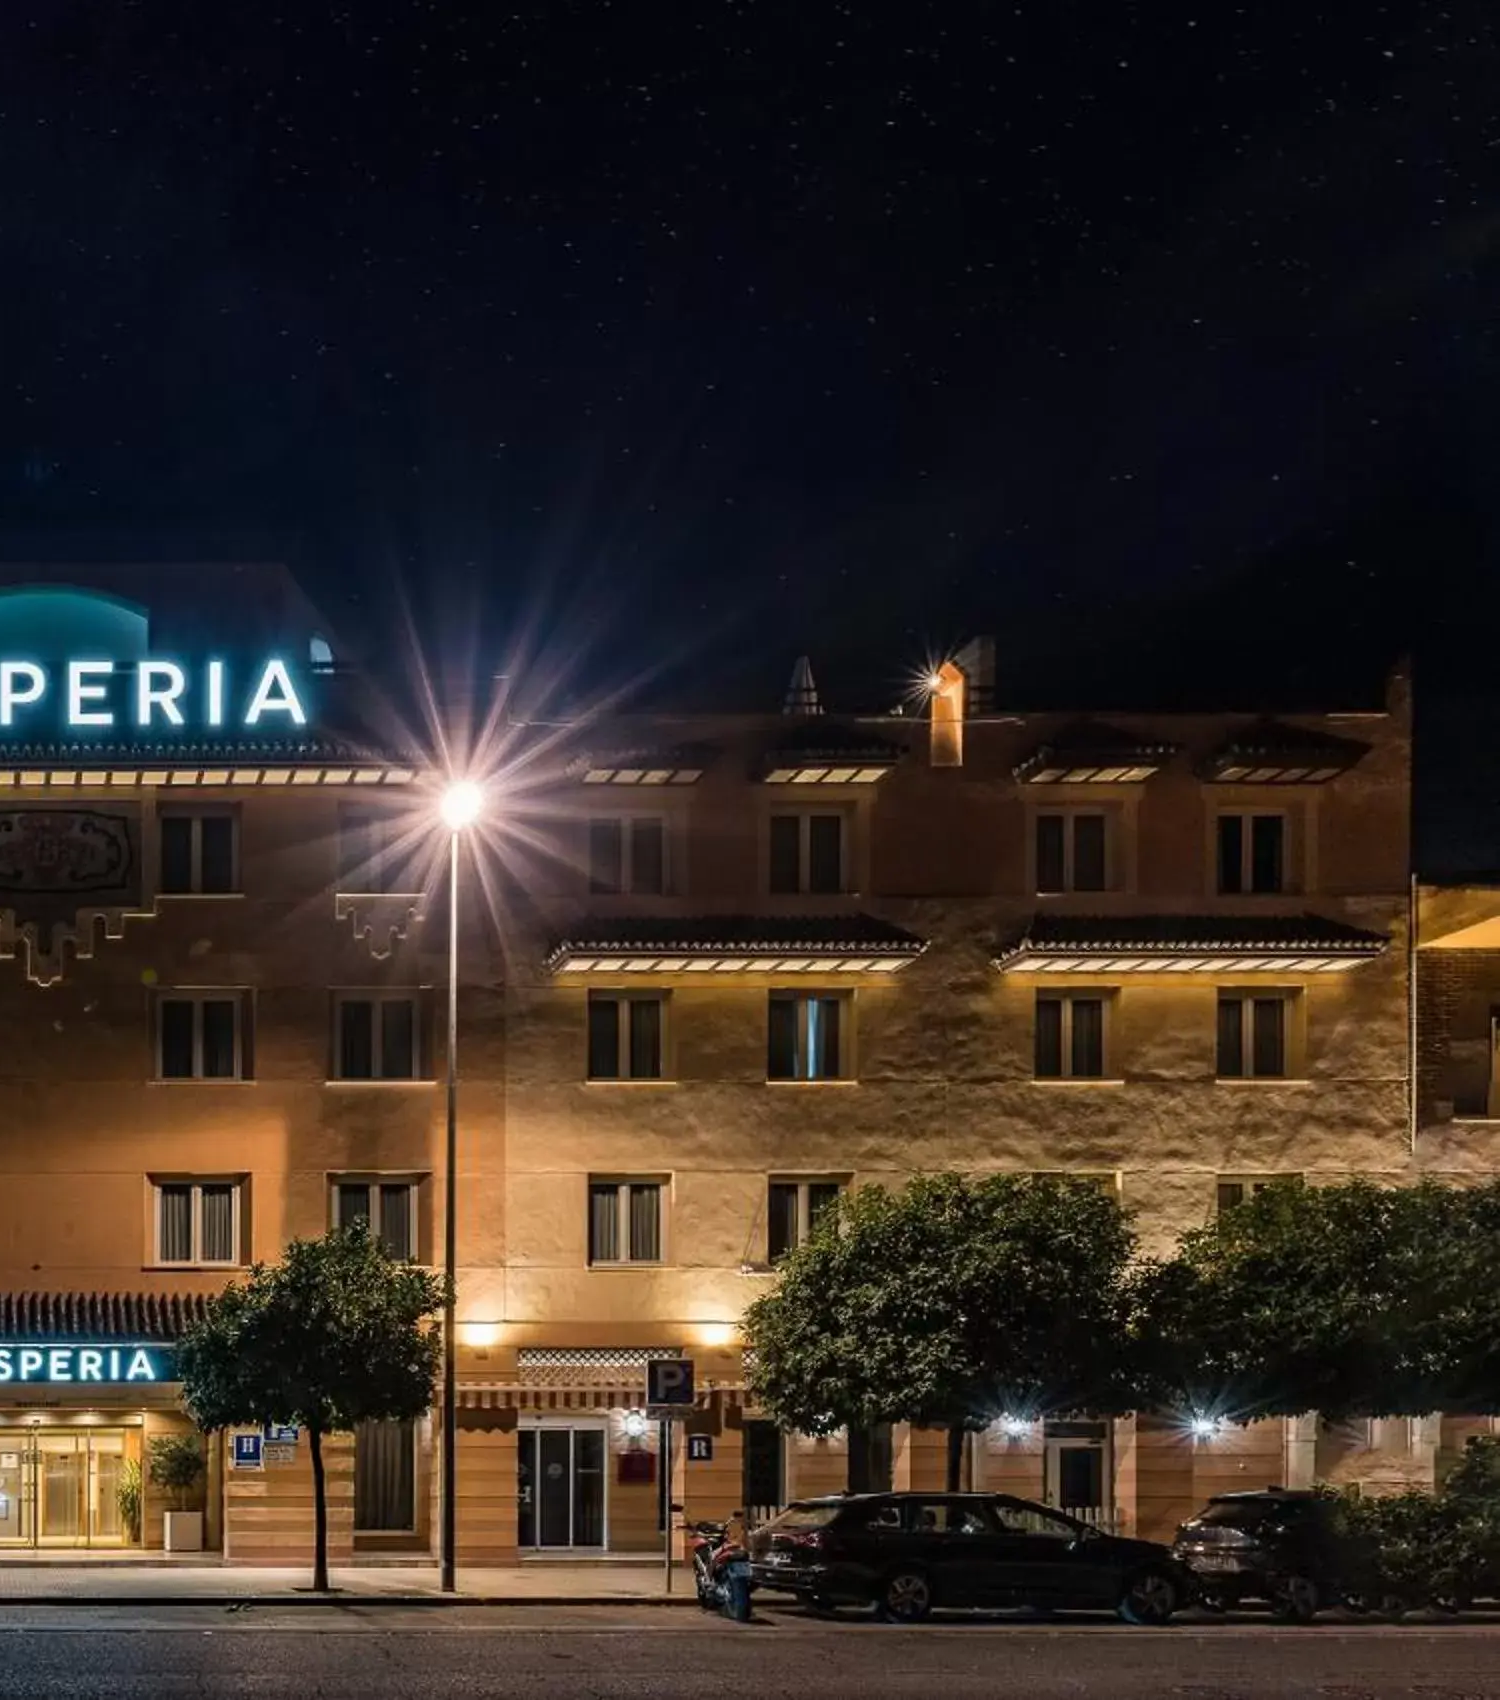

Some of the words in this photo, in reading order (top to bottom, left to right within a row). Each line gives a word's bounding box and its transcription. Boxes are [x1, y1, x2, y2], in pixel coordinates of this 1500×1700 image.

[657, 1364, 685, 1399] P
[242, 1437, 255, 1453] H
[691, 1439, 709, 1457] R
